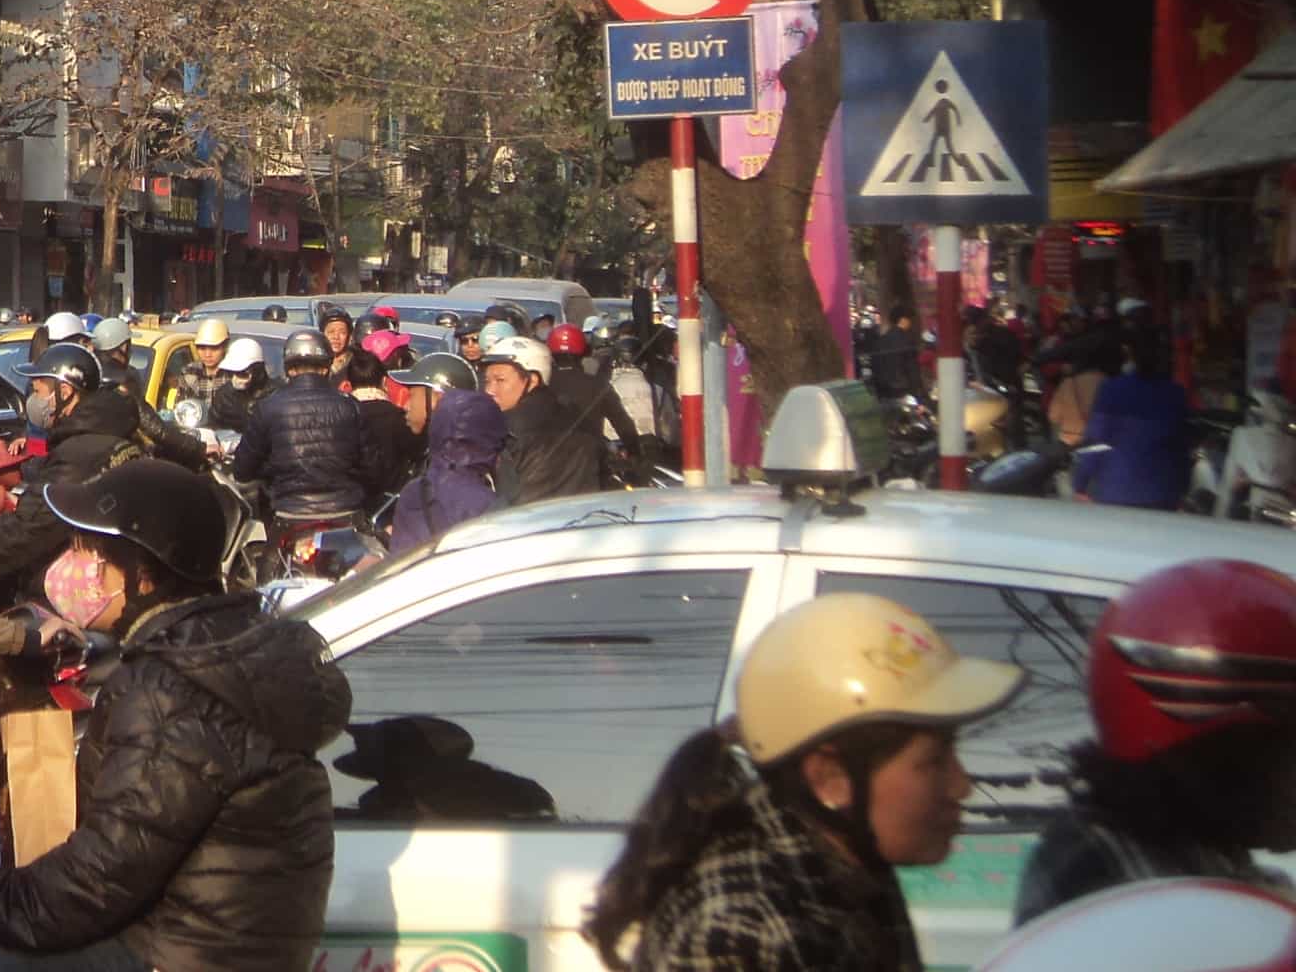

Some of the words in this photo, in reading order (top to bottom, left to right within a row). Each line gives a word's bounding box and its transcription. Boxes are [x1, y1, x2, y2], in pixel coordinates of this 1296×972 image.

[633, 42, 662, 61] XE
[669, 35, 728, 59] BUÝT
[616, 80, 648, 104] ĐƯỢC
[650, 76, 680, 101] PHÉP
[682, 79, 712, 101] HOẠT
[714, 73, 745, 100] ĐỘNG
